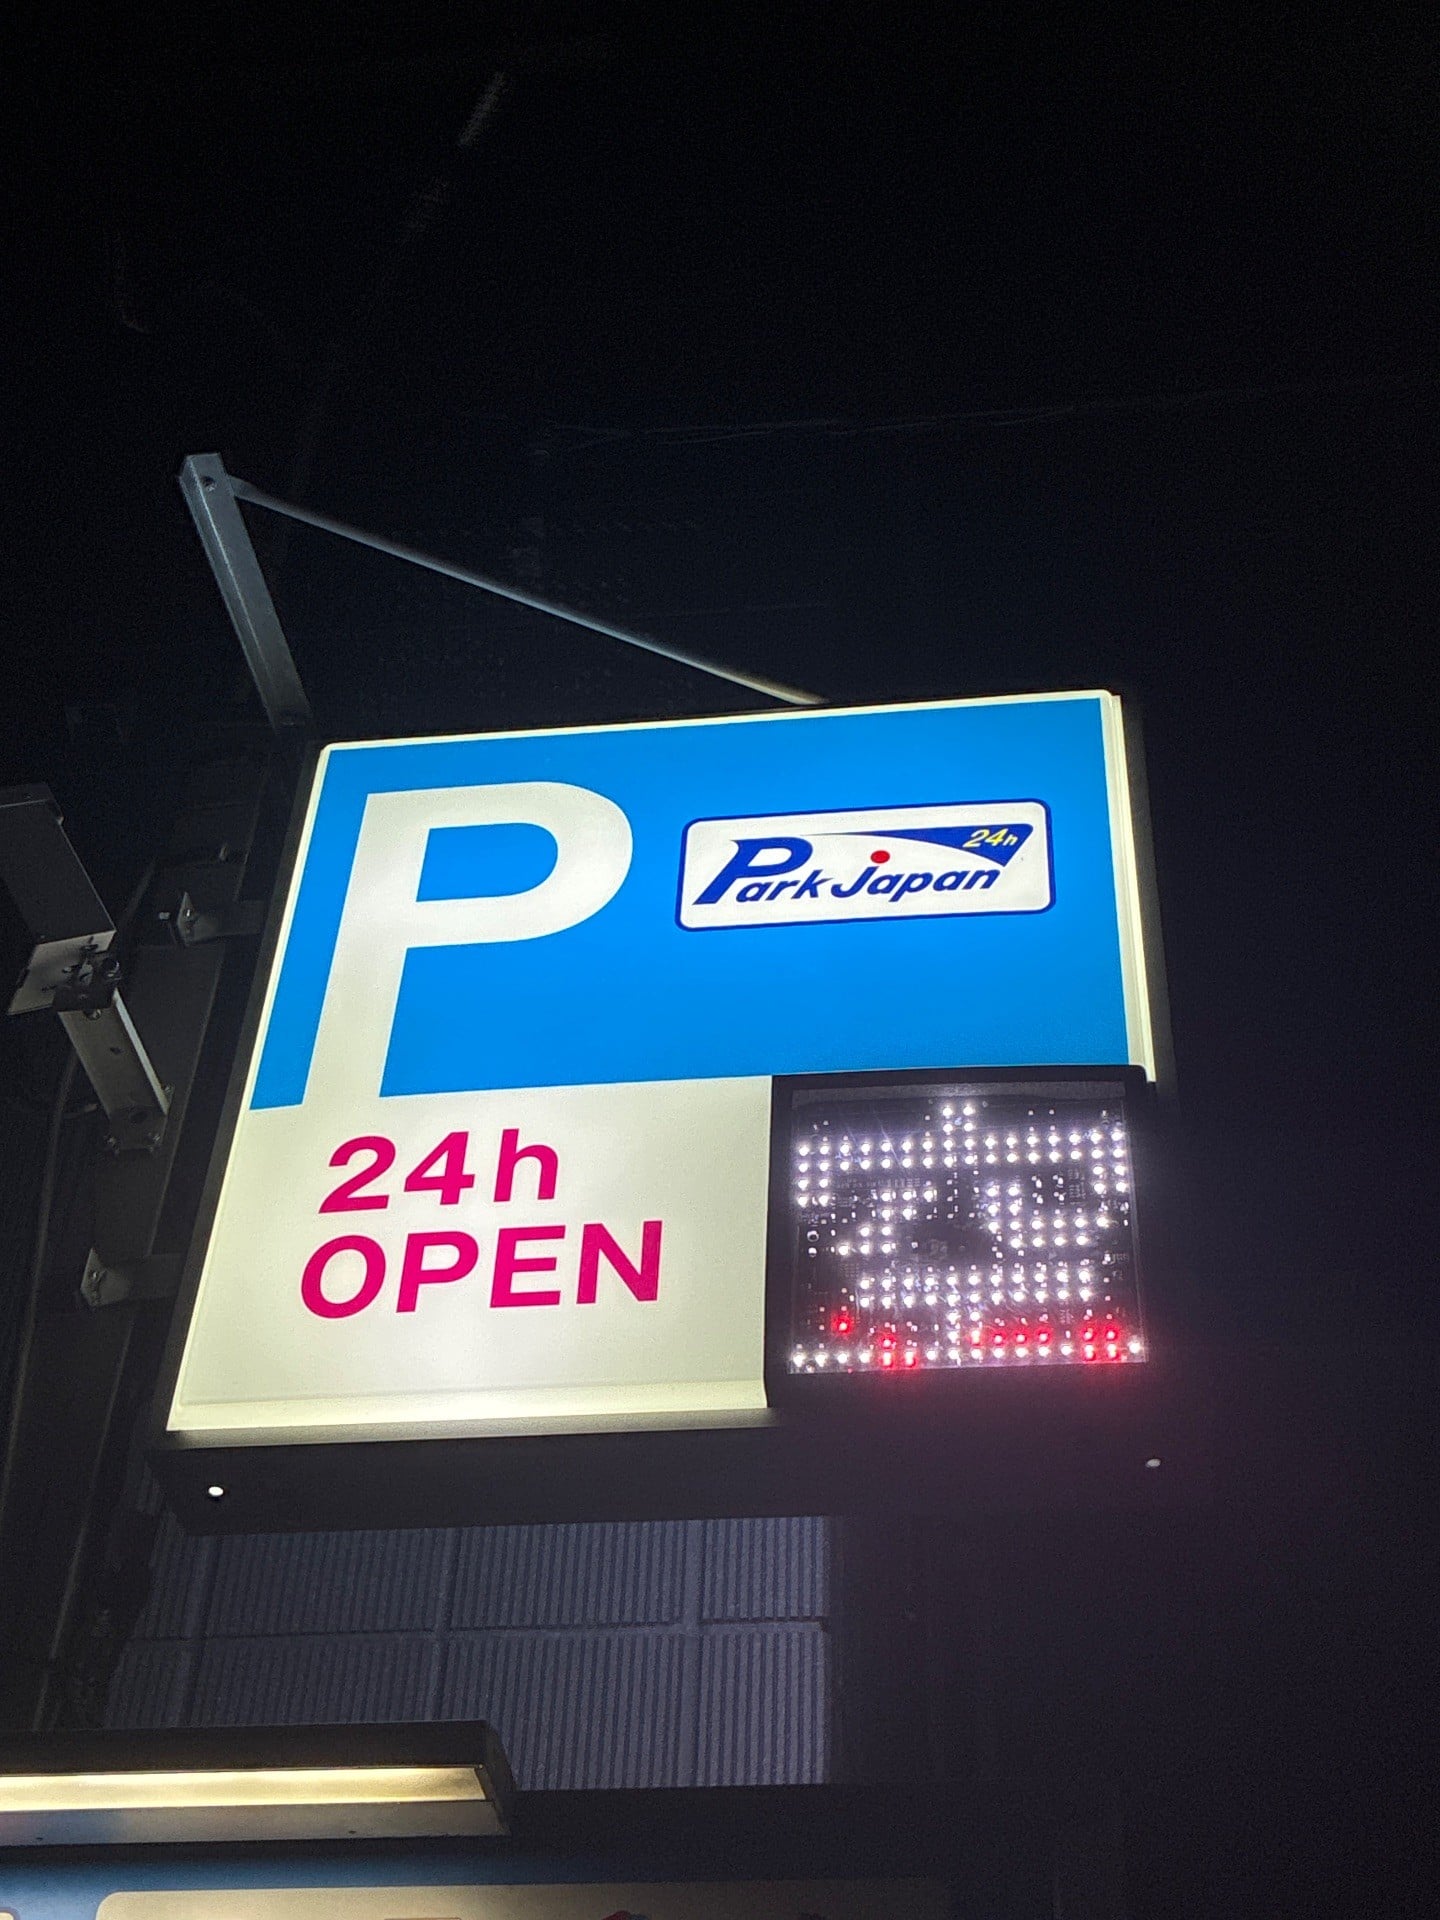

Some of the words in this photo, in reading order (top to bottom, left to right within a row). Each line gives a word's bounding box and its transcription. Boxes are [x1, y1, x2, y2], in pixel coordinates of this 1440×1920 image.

[692, 835, 836, 905] Park
[830, 849, 1001, 902] Japan
[962, 827, 1019, 849] 24h
[302, 780, 633, 1106] P
[318, 1128, 560, 1214] 24h
[300, 1219, 664, 1320] OPEN
